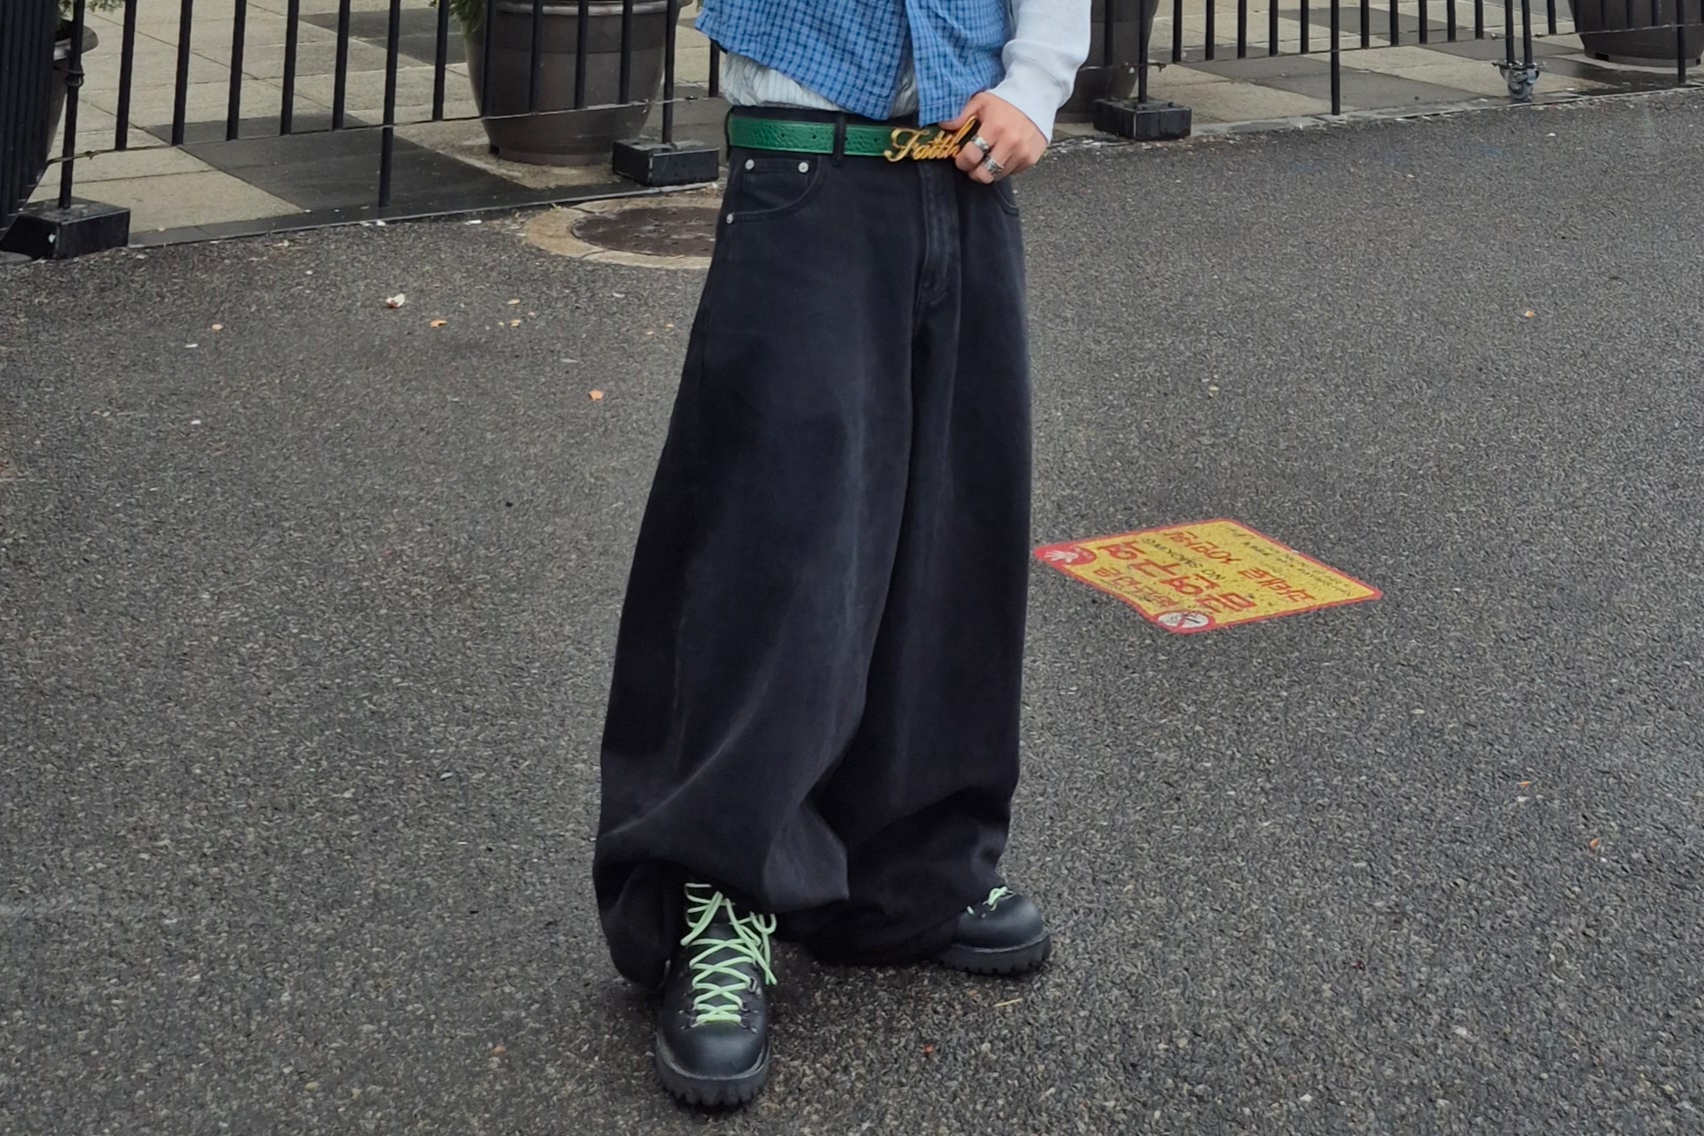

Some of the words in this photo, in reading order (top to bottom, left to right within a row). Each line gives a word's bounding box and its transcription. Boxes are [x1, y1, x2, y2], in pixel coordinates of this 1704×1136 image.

[1140, 537, 1202, 569] SMOKING
[1098, 539, 1257, 613] 금연구역
[1202, 568, 1226, 581] NO
